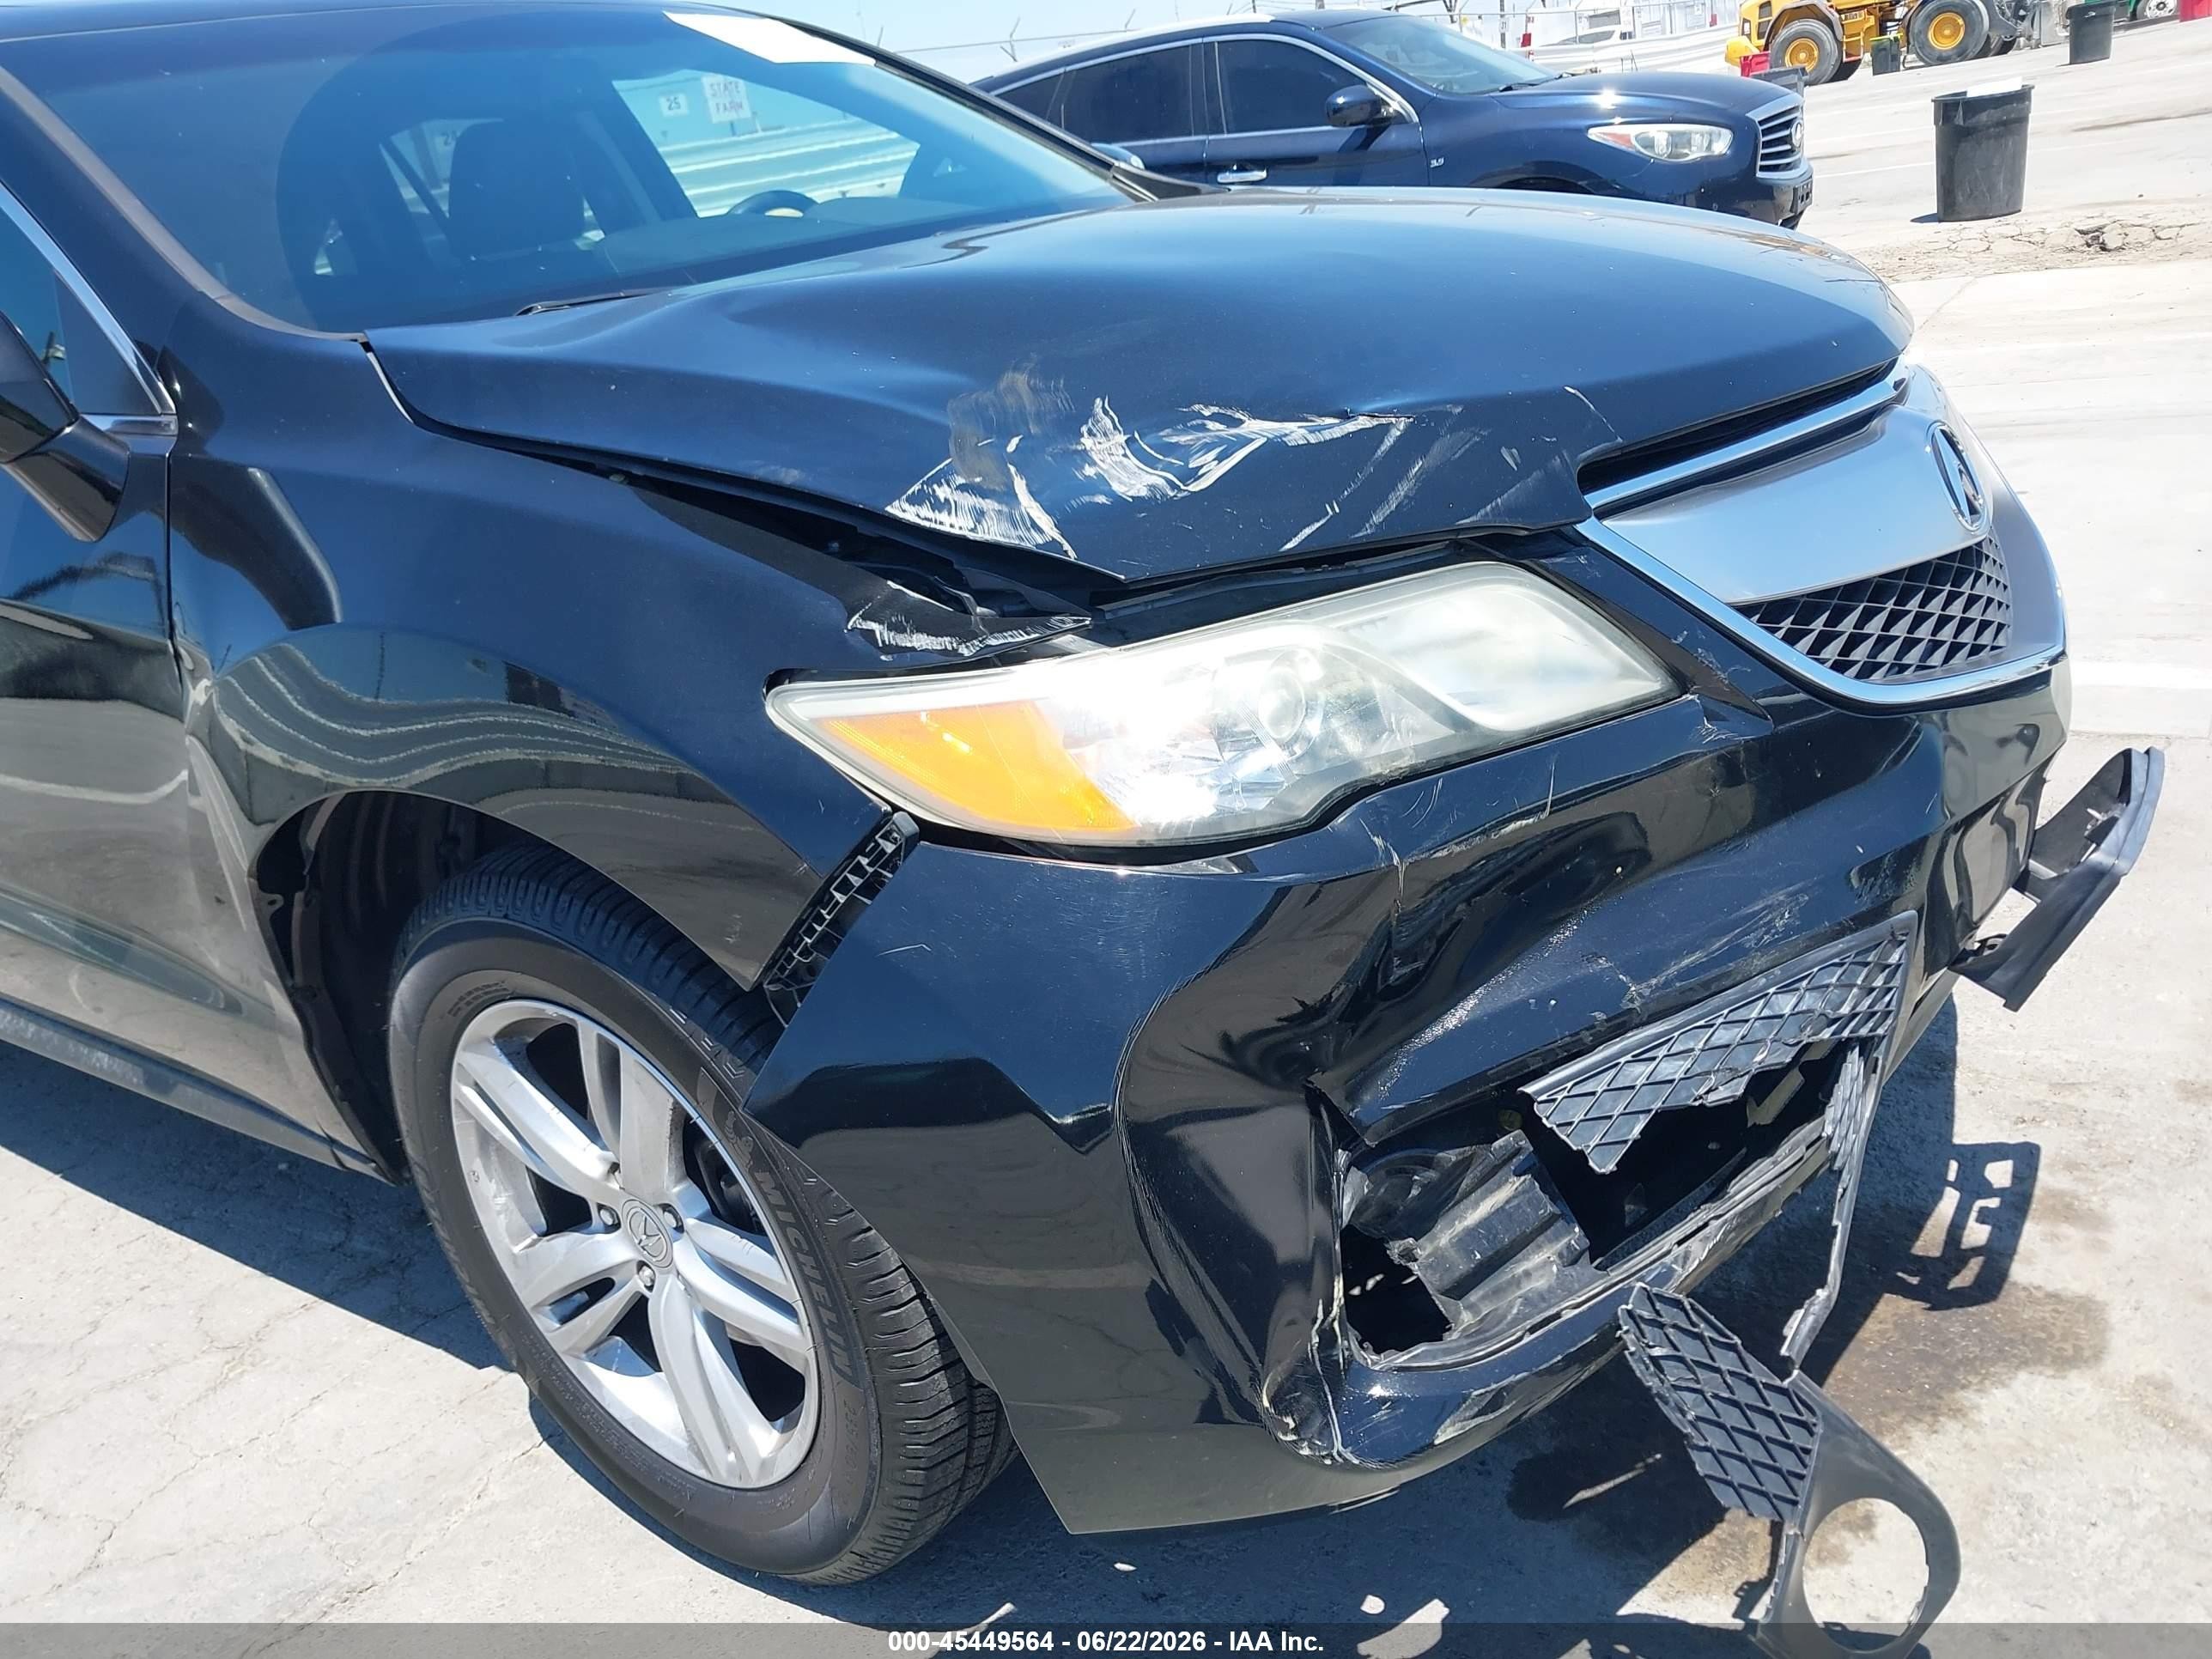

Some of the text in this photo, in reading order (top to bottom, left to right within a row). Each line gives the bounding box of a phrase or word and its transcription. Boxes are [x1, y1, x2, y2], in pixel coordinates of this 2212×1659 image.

[709, 81, 741, 98] STATE
[665, 96, 682, 111] 25
[714, 100, 744, 112] FARM
[754, 1170, 854, 1376] MICHELIN
